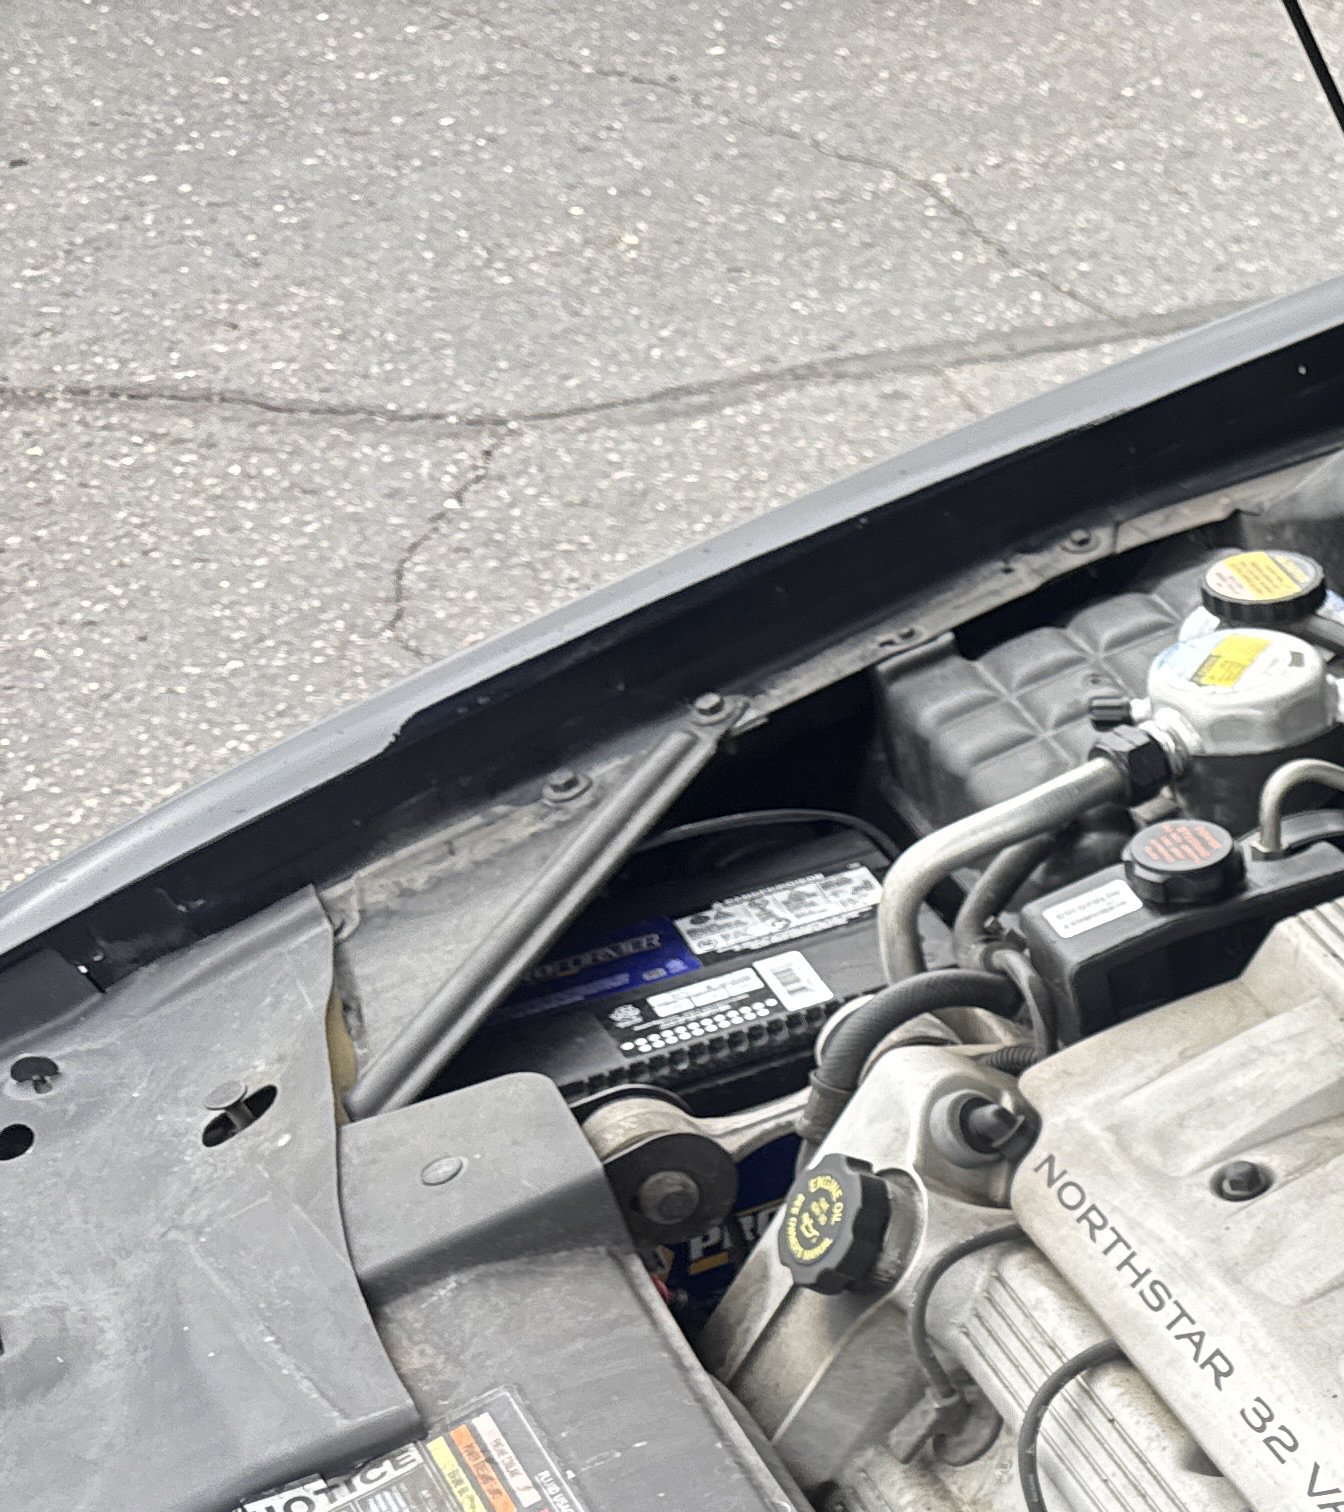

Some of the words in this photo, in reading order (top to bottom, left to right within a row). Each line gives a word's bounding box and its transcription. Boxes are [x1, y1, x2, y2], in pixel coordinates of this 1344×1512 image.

[830, 1202, 844, 1225] OIL
[1034, 1153, 1235, 1390] NORTHSTAR
[1240, 1396, 1300, 1464] 32
